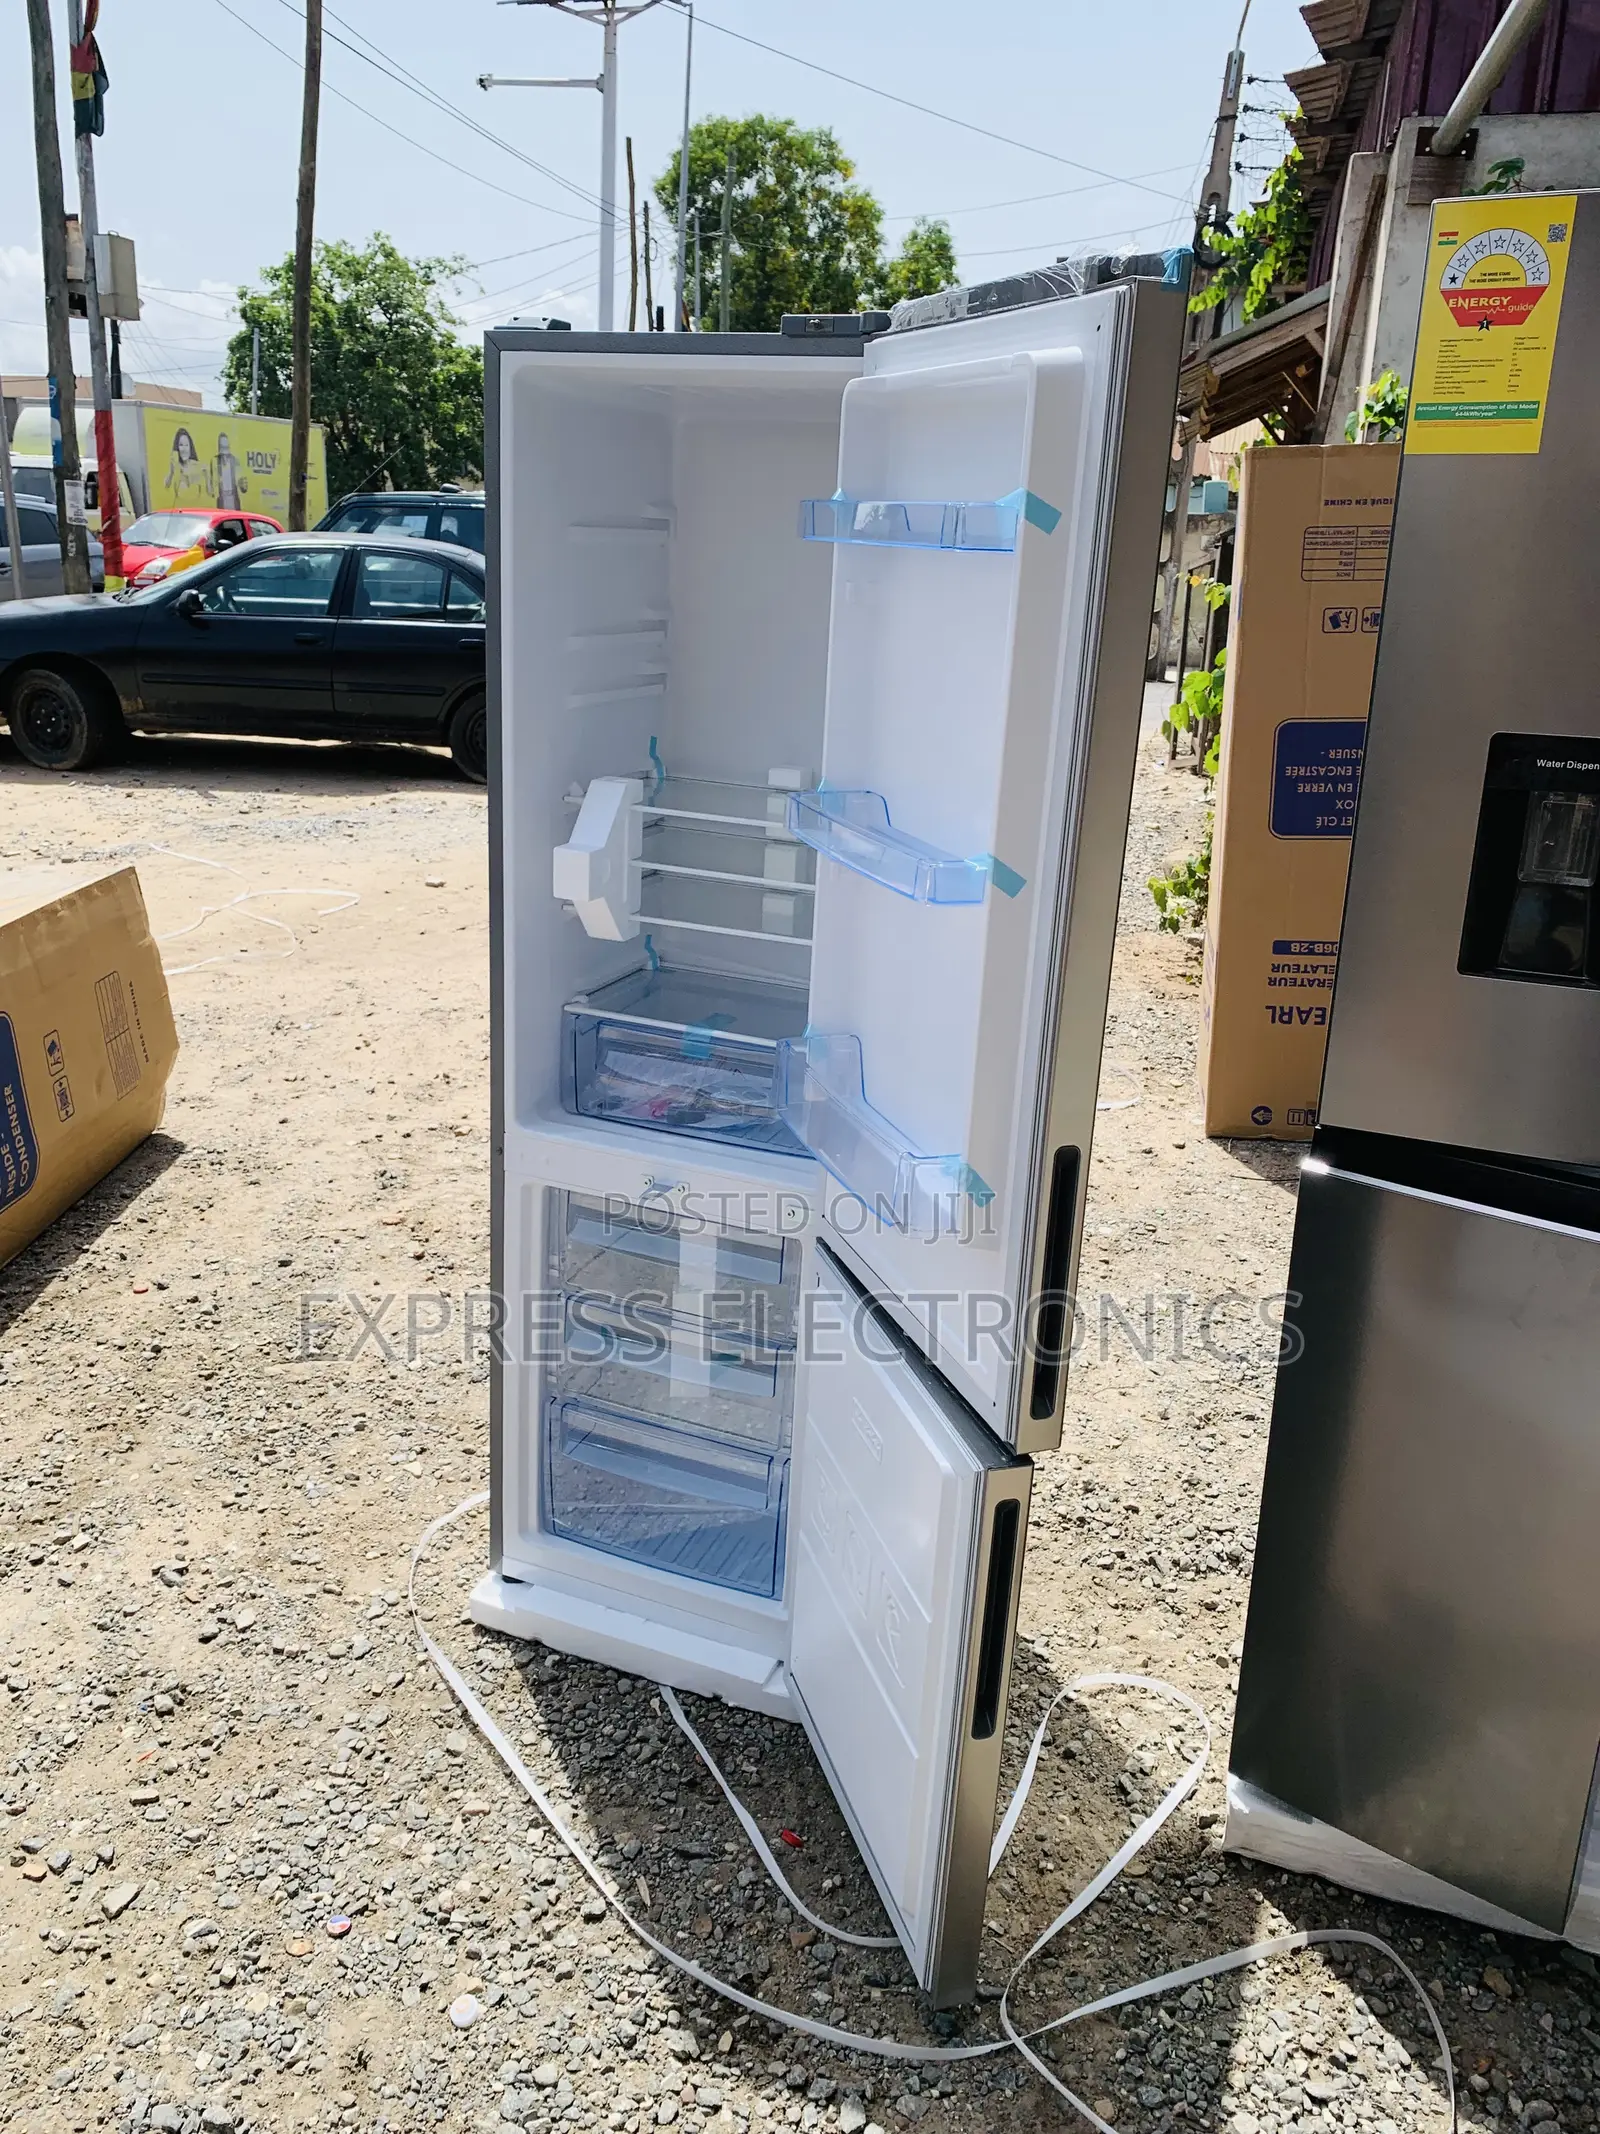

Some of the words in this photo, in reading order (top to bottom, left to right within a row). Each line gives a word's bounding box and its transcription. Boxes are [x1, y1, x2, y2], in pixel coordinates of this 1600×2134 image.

[1448, 296, 1512, 310] ENERGY
[1507, 303, 1535, 313] guide
[1459, 404, 1498, 412] Consumption
[247, 451, 276, 468] HOLY
[1536, 759, 1565, 768] Water
[1566, 760, 1600, 771] Dispen
[1285, 766, 1352, 778] ENCASTRÉE
[1297, 783, 1333, 792] VERRE
[1338, 783, 1352, 792] EN
[1316, 816, 1337, 828] CLÉ
[1340, 816, 1352, 825] ET
[128, 980, 138, 1016] CHINA
[1265, 1005, 1326, 1025] EARL
[4, 1084, 30, 1188] CONDENSER
[0, 1144, 17, 1197] INSIDE
